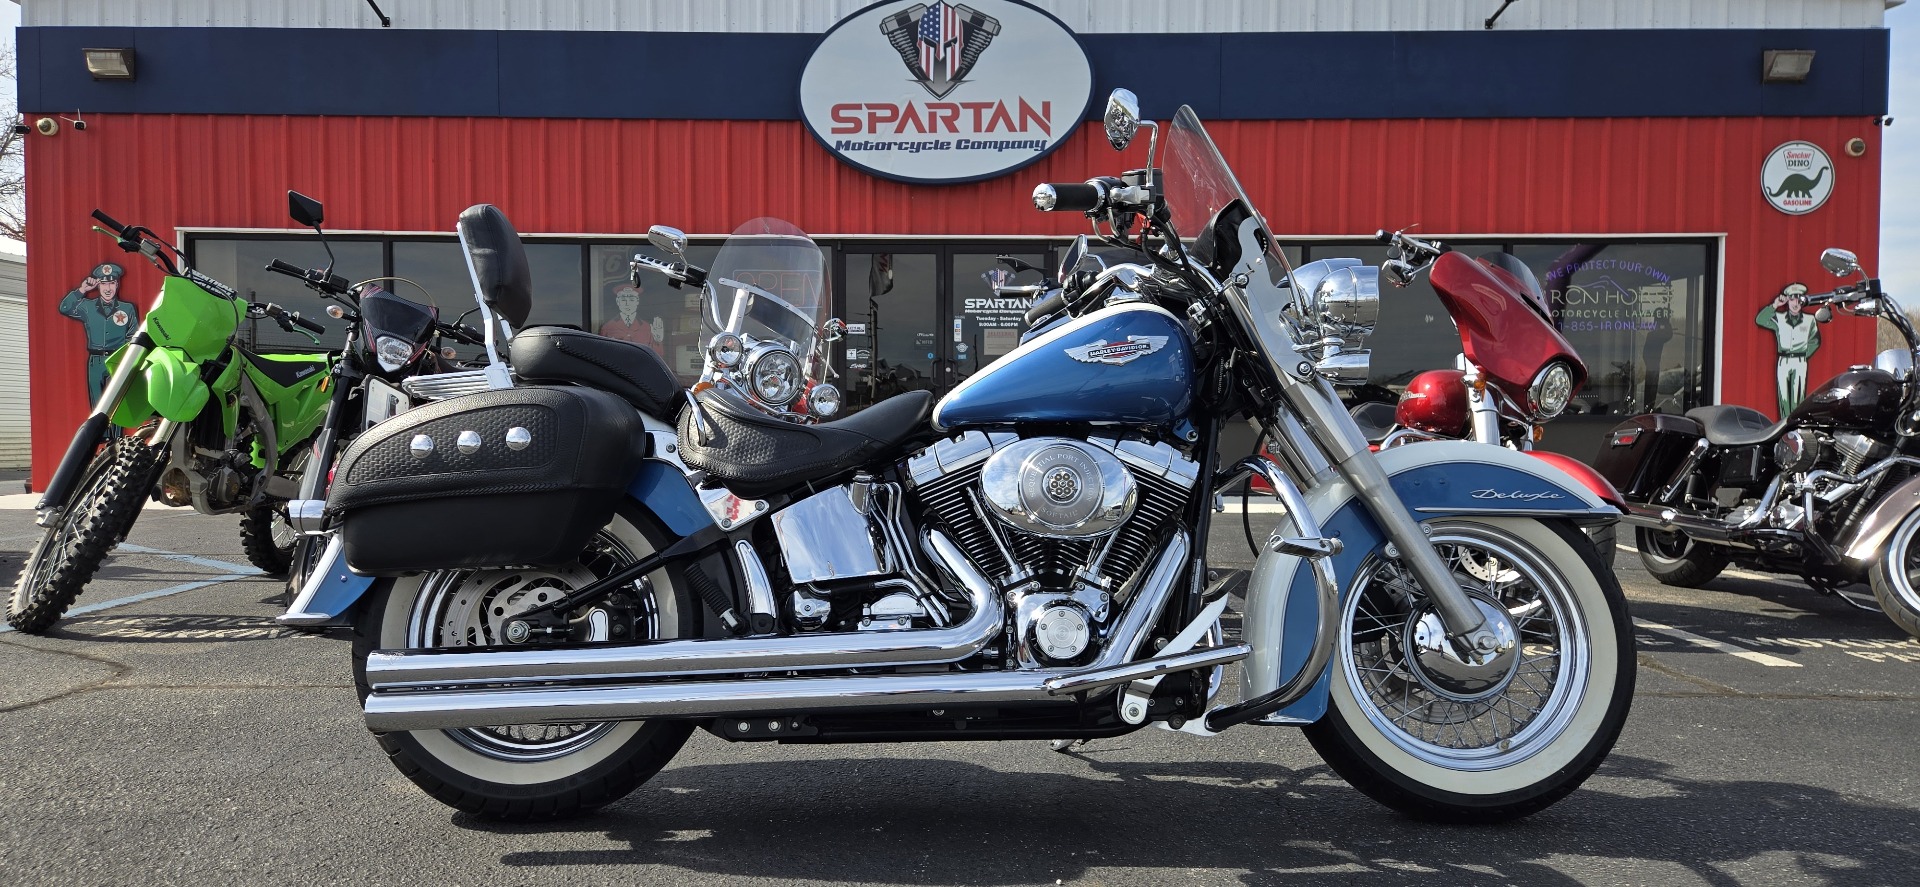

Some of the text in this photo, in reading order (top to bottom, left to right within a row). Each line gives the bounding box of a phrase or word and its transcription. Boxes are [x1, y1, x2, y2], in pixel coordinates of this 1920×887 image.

[831, 96, 1050, 137] SPARTAN
[835, 138, 1048, 153] Motorcycle Company
[1546, 260, 1671, 284] WE PROTECT OUR OWN
[964, 297, 1032, 309] SPARTAN
[1551, 309, 1619, 318] OTORCYCLE
[1057, 453, 1078, 463] PORT
[1469, 488, 1565, 501] Deluxe
